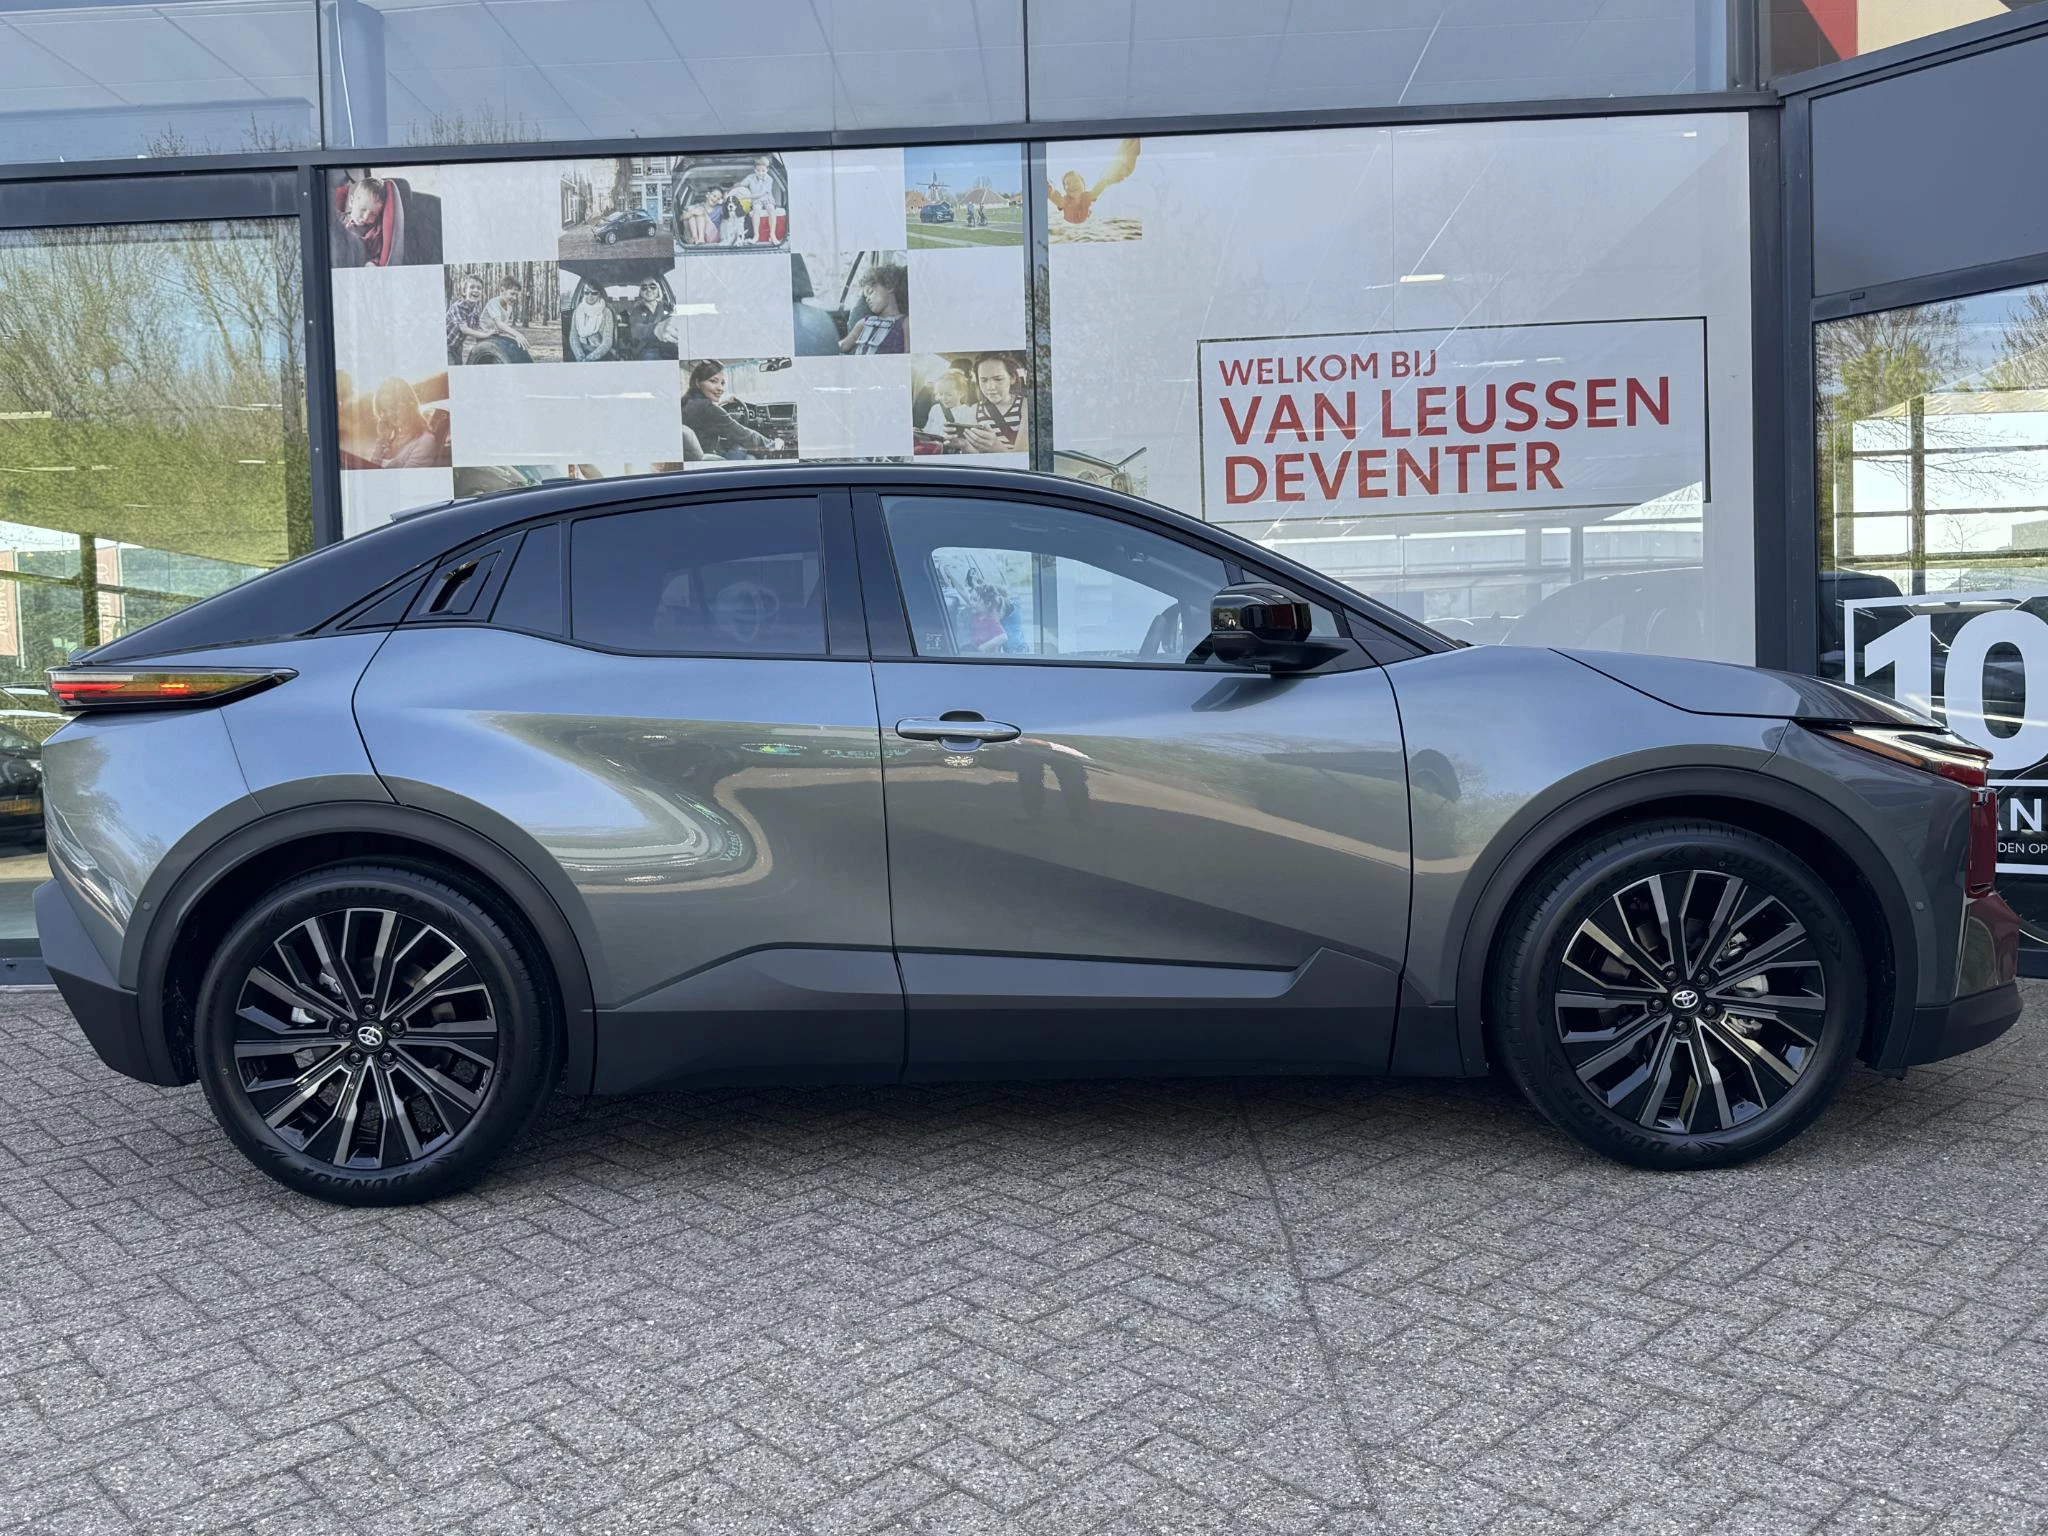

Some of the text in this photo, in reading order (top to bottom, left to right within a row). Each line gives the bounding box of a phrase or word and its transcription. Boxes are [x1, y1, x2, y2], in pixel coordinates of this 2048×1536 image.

[1218, 349, 1437, 387] WELKOM BIJ
[1218, 375, 1670, 446] VAN LEUSSEN
[1225, 440, 1565, 505] DEVENTER
[292, 1165, 411, 1190] DUNLOP
